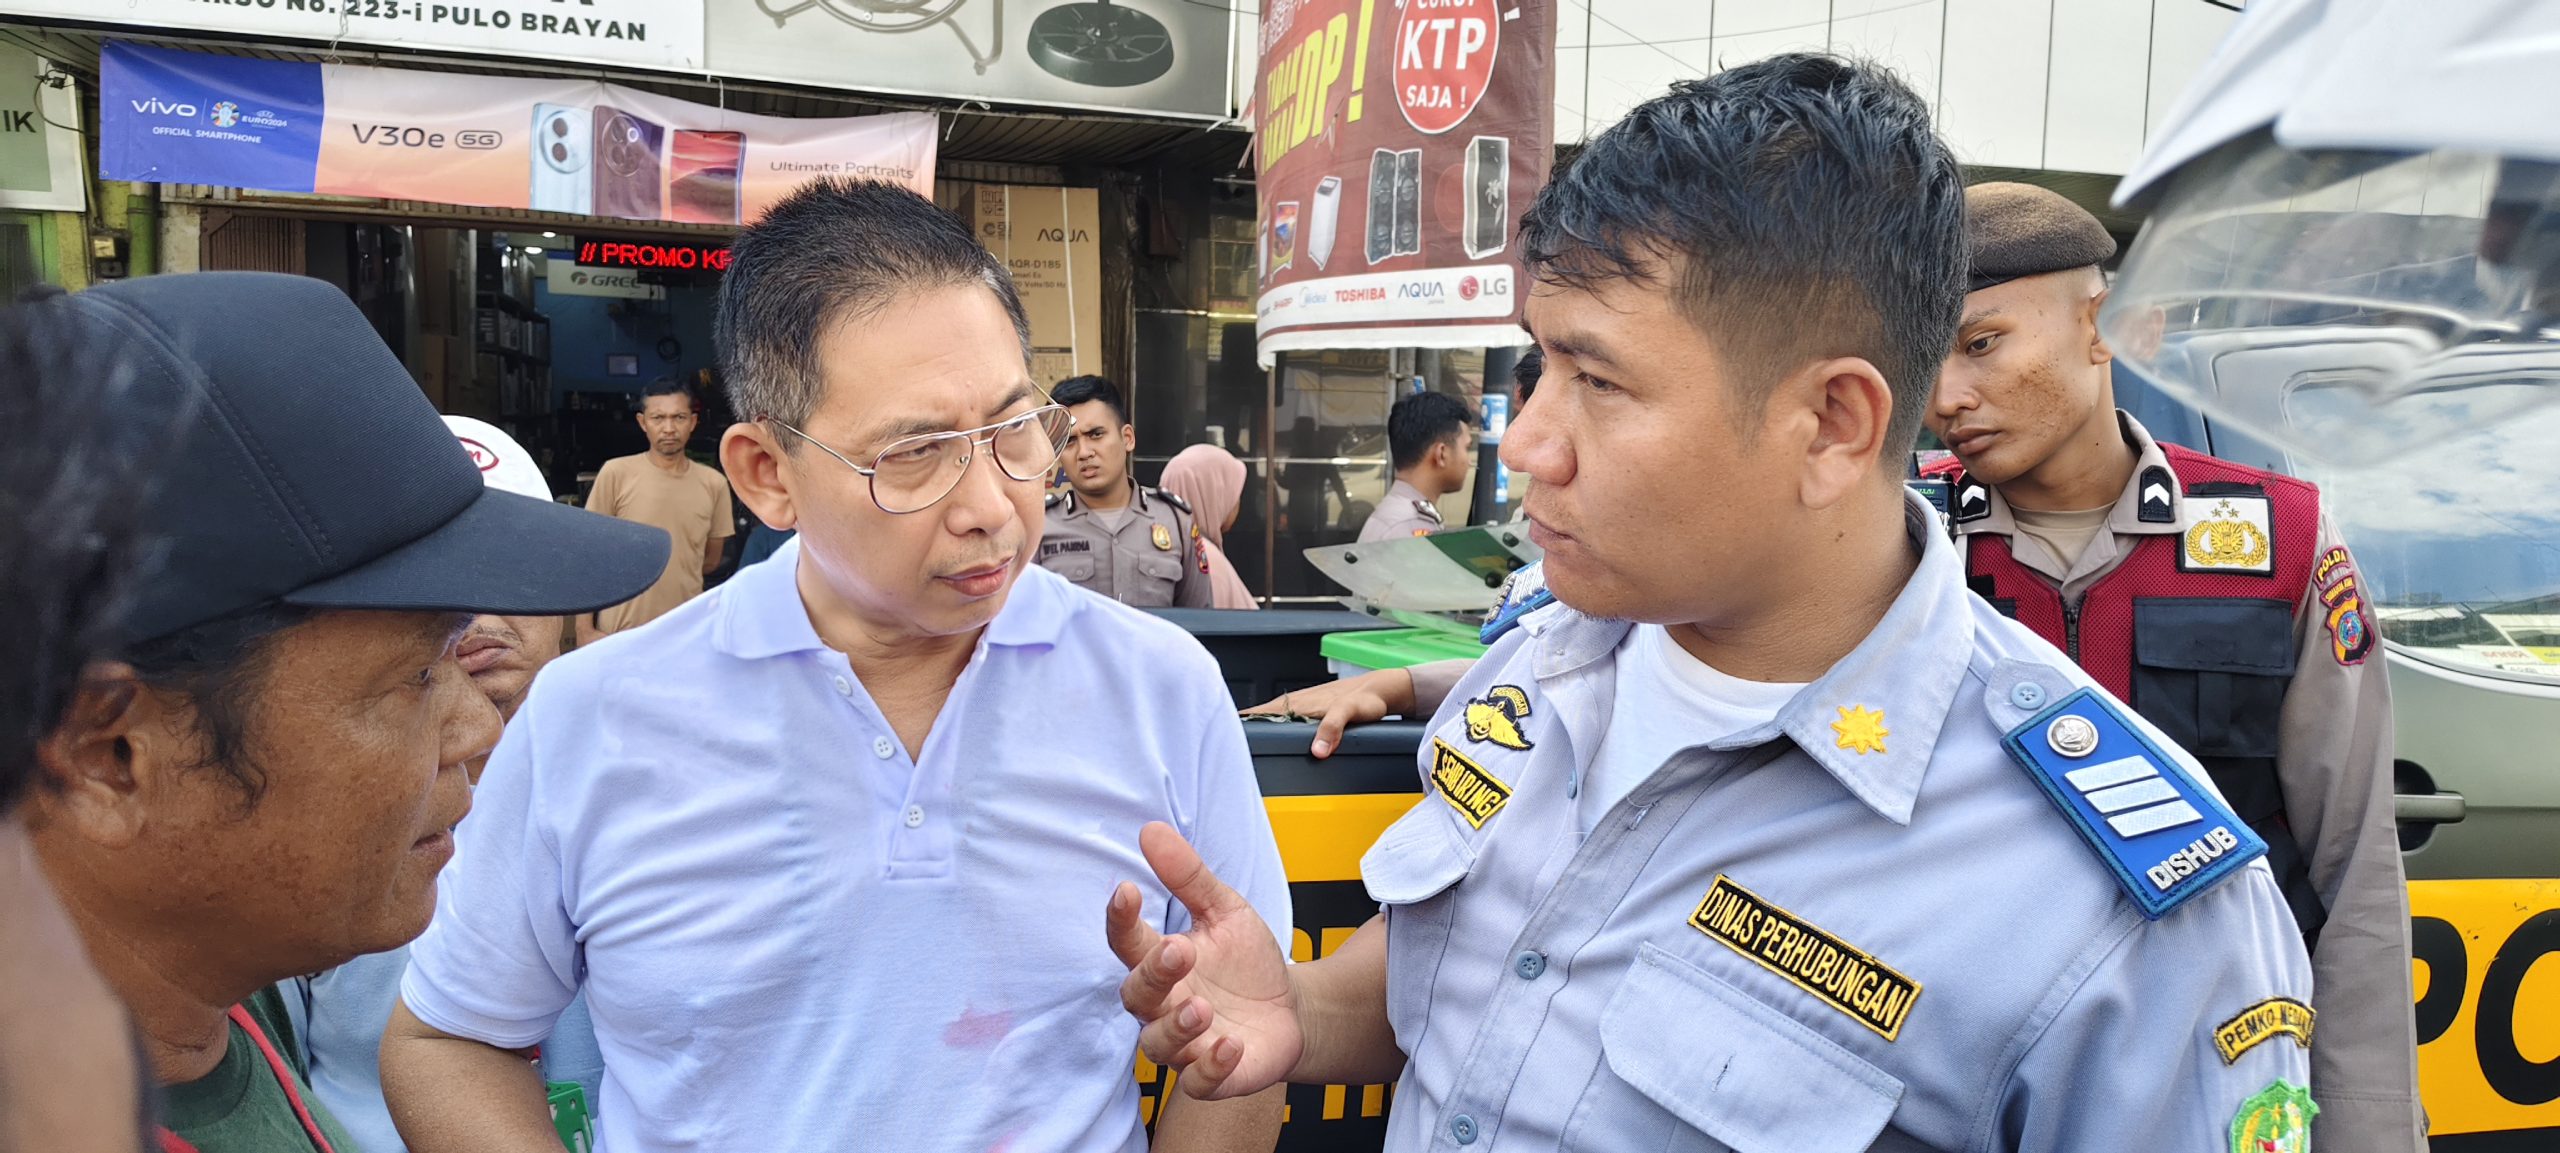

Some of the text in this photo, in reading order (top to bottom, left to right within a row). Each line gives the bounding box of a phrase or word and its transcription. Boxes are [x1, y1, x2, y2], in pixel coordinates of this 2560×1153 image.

[432, 5, 511, 28] PULO
[521, 13, 646, 41] BRAYAN
[1400, 17, 1487, 70] KTP
[131, 97, 197, 117] vivo
[1405, 85, 1453, 108] SAJA
[152, 126, 262, 144] OFFICIAL SMARTPHONE
[352, 123, 494, 148] V30e 5G
[770, 161, 915, 180] Ultimate Portraits
[601, 242, 697, 268] PROMO
[1335, 287, 1386, 303] TOSHIBA
[1397, 281, 1445, 298] AQUA
[1483, 277, 1507, 296] LG
[2317, 549, 2347, 581] POLDA
[2146, 825, 2238, 890] DISHUB
[1700, 886, 1908, 1028] DINAS PERHUBUNGAN
